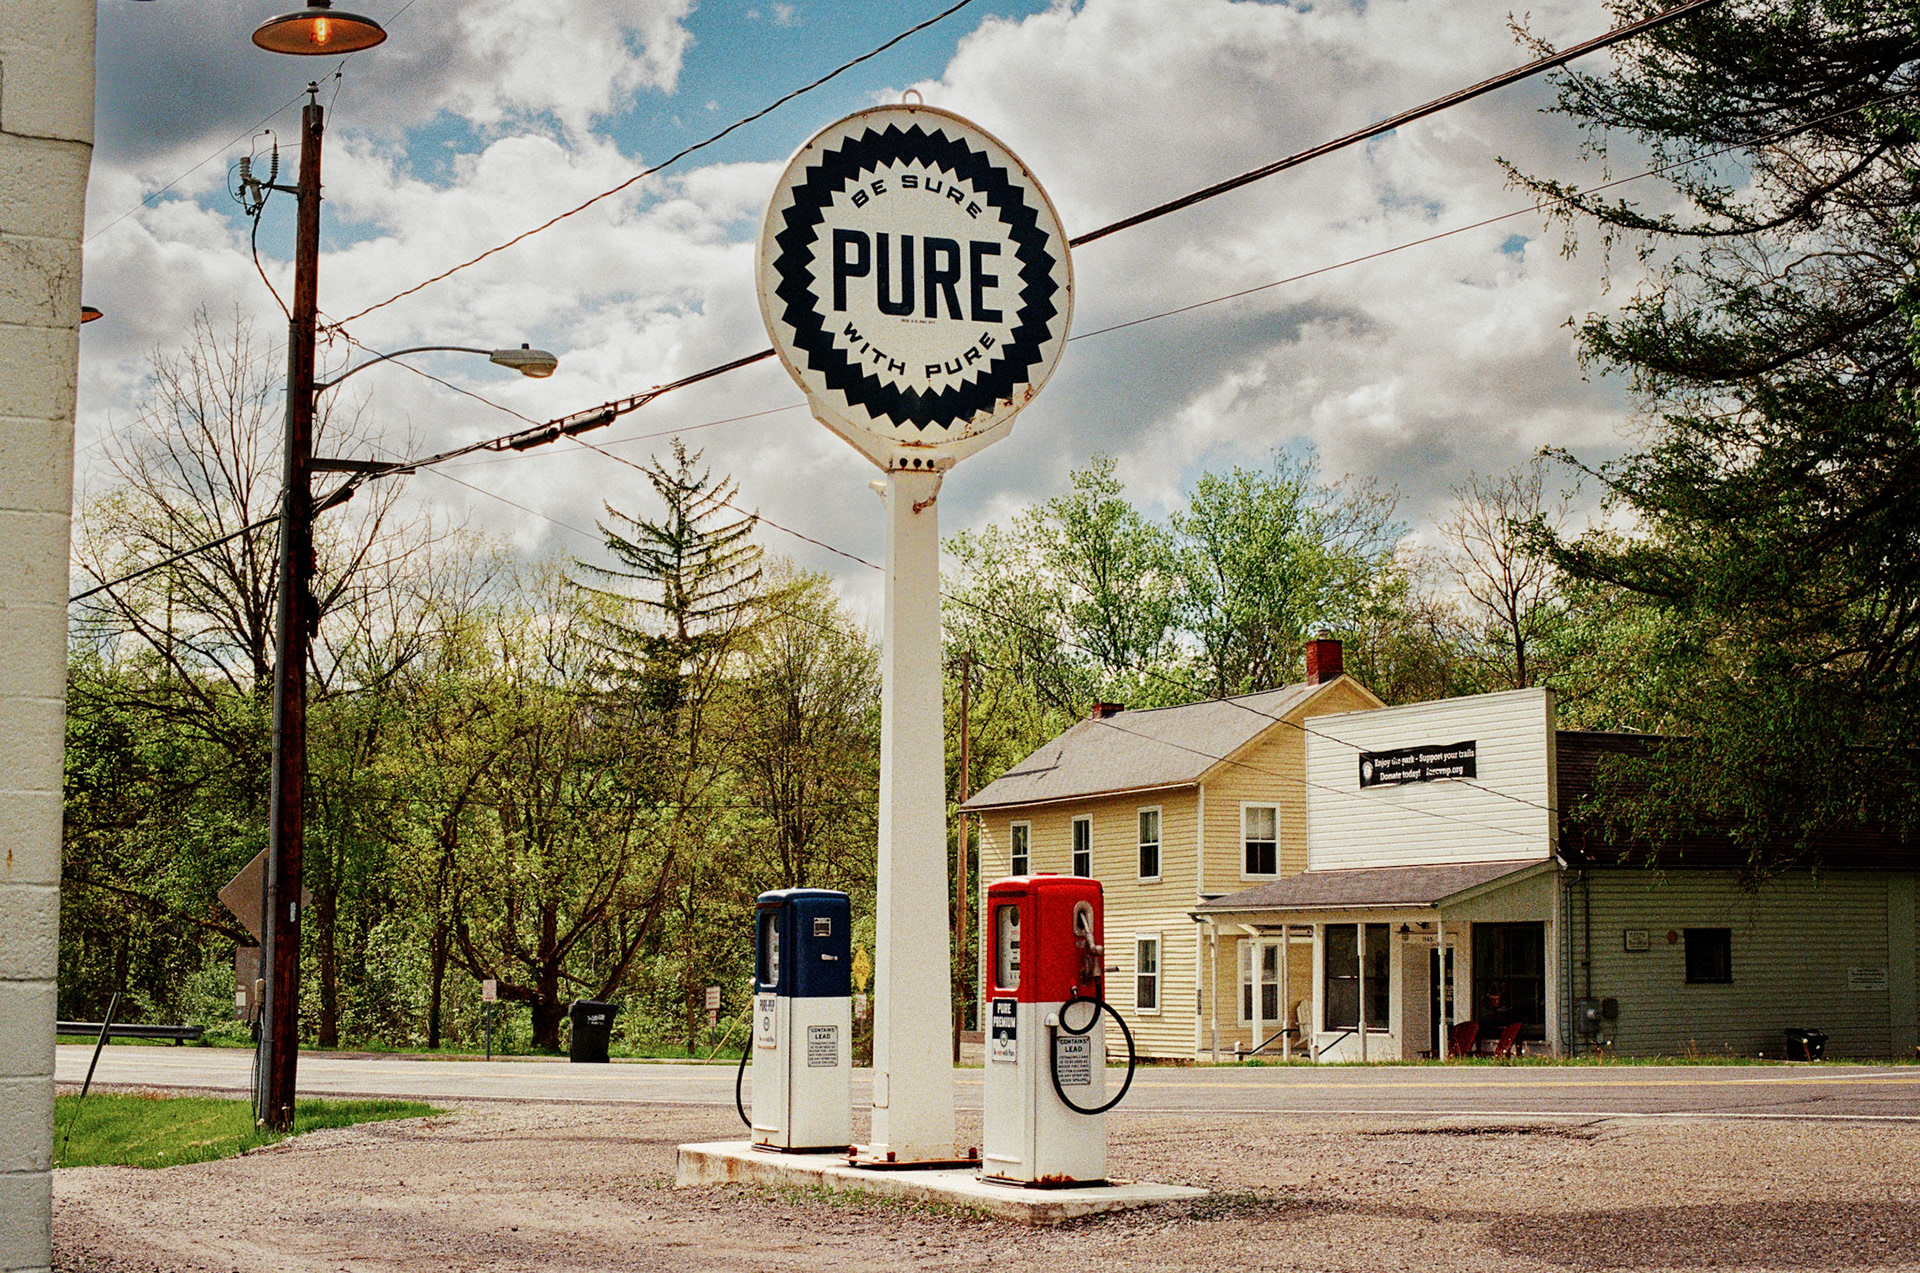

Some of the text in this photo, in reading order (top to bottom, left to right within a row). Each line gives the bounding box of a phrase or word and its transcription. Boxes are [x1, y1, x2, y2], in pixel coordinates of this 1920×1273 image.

[851, 174, 983, 219] BE SURE
[832, 228, 1003, 323] PURE
[843, 321, 906, 376] WITH
[925, 331, 996, 379] PURE
[1374, 758, 1391, 769] Enjoy
[1401, 755, 1415, 766] park
[1419, 753, 1443, 764] Support
[1443, 752, 1458, 762] your
[1380, 772, 1401, 781] Donate
[993, 1016, 1016, 1028] PREMIUM
[997, 1002, 1012, 1014] PURE
